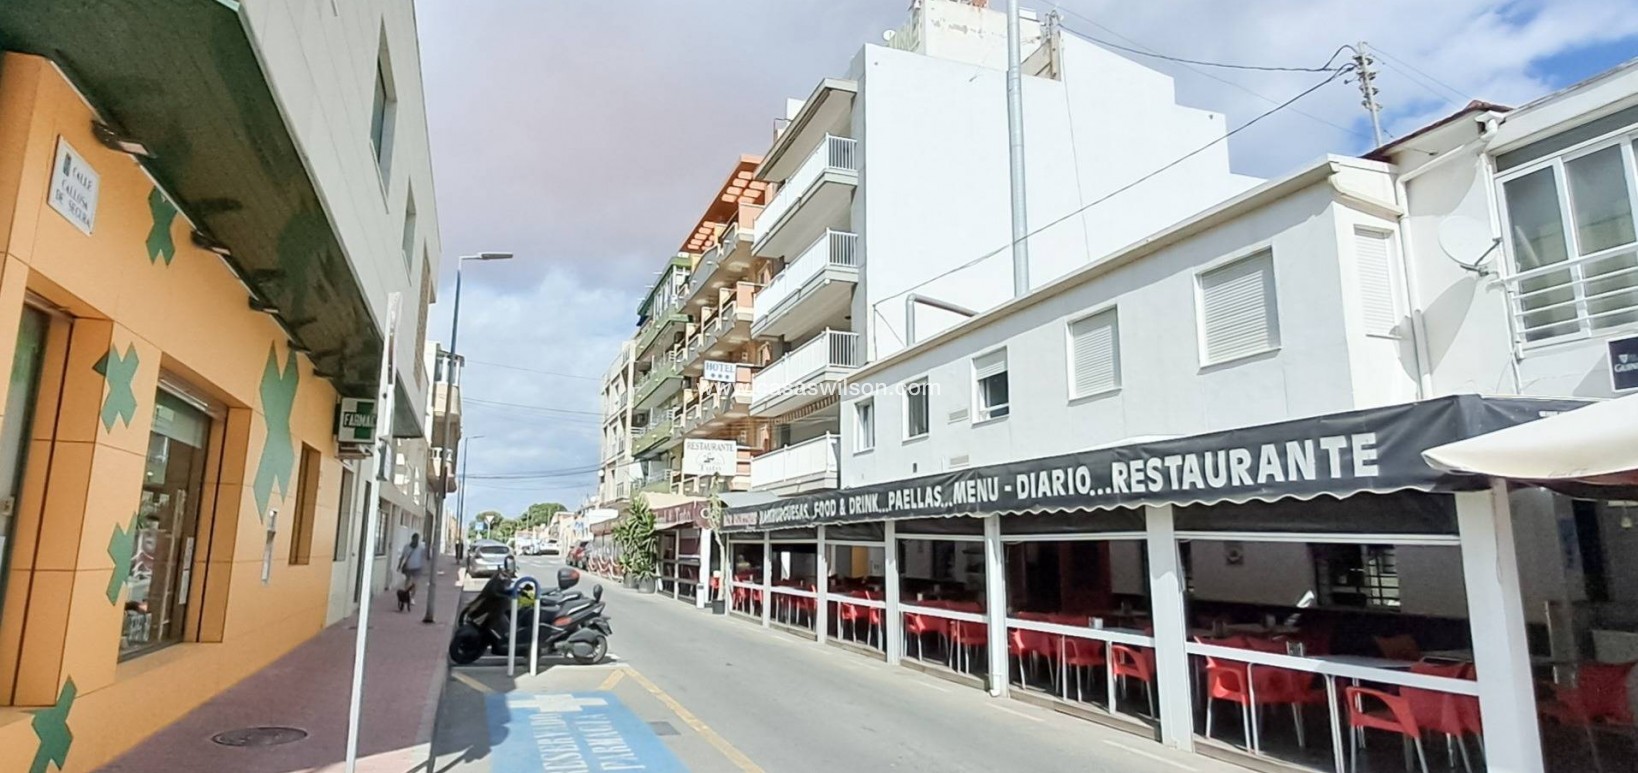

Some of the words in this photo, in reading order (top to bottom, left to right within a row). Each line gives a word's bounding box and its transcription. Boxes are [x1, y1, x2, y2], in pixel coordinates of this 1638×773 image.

[73, 167, 92, 191] CALLE
[56, 188, 64, 204] DE
[705, 361, 735, 373] HOTEL
[686, 441, 735, 453] RESTAURANTE
[840, 498, 847, 516] &
[574, 713, 646, 771] FARMACIA
